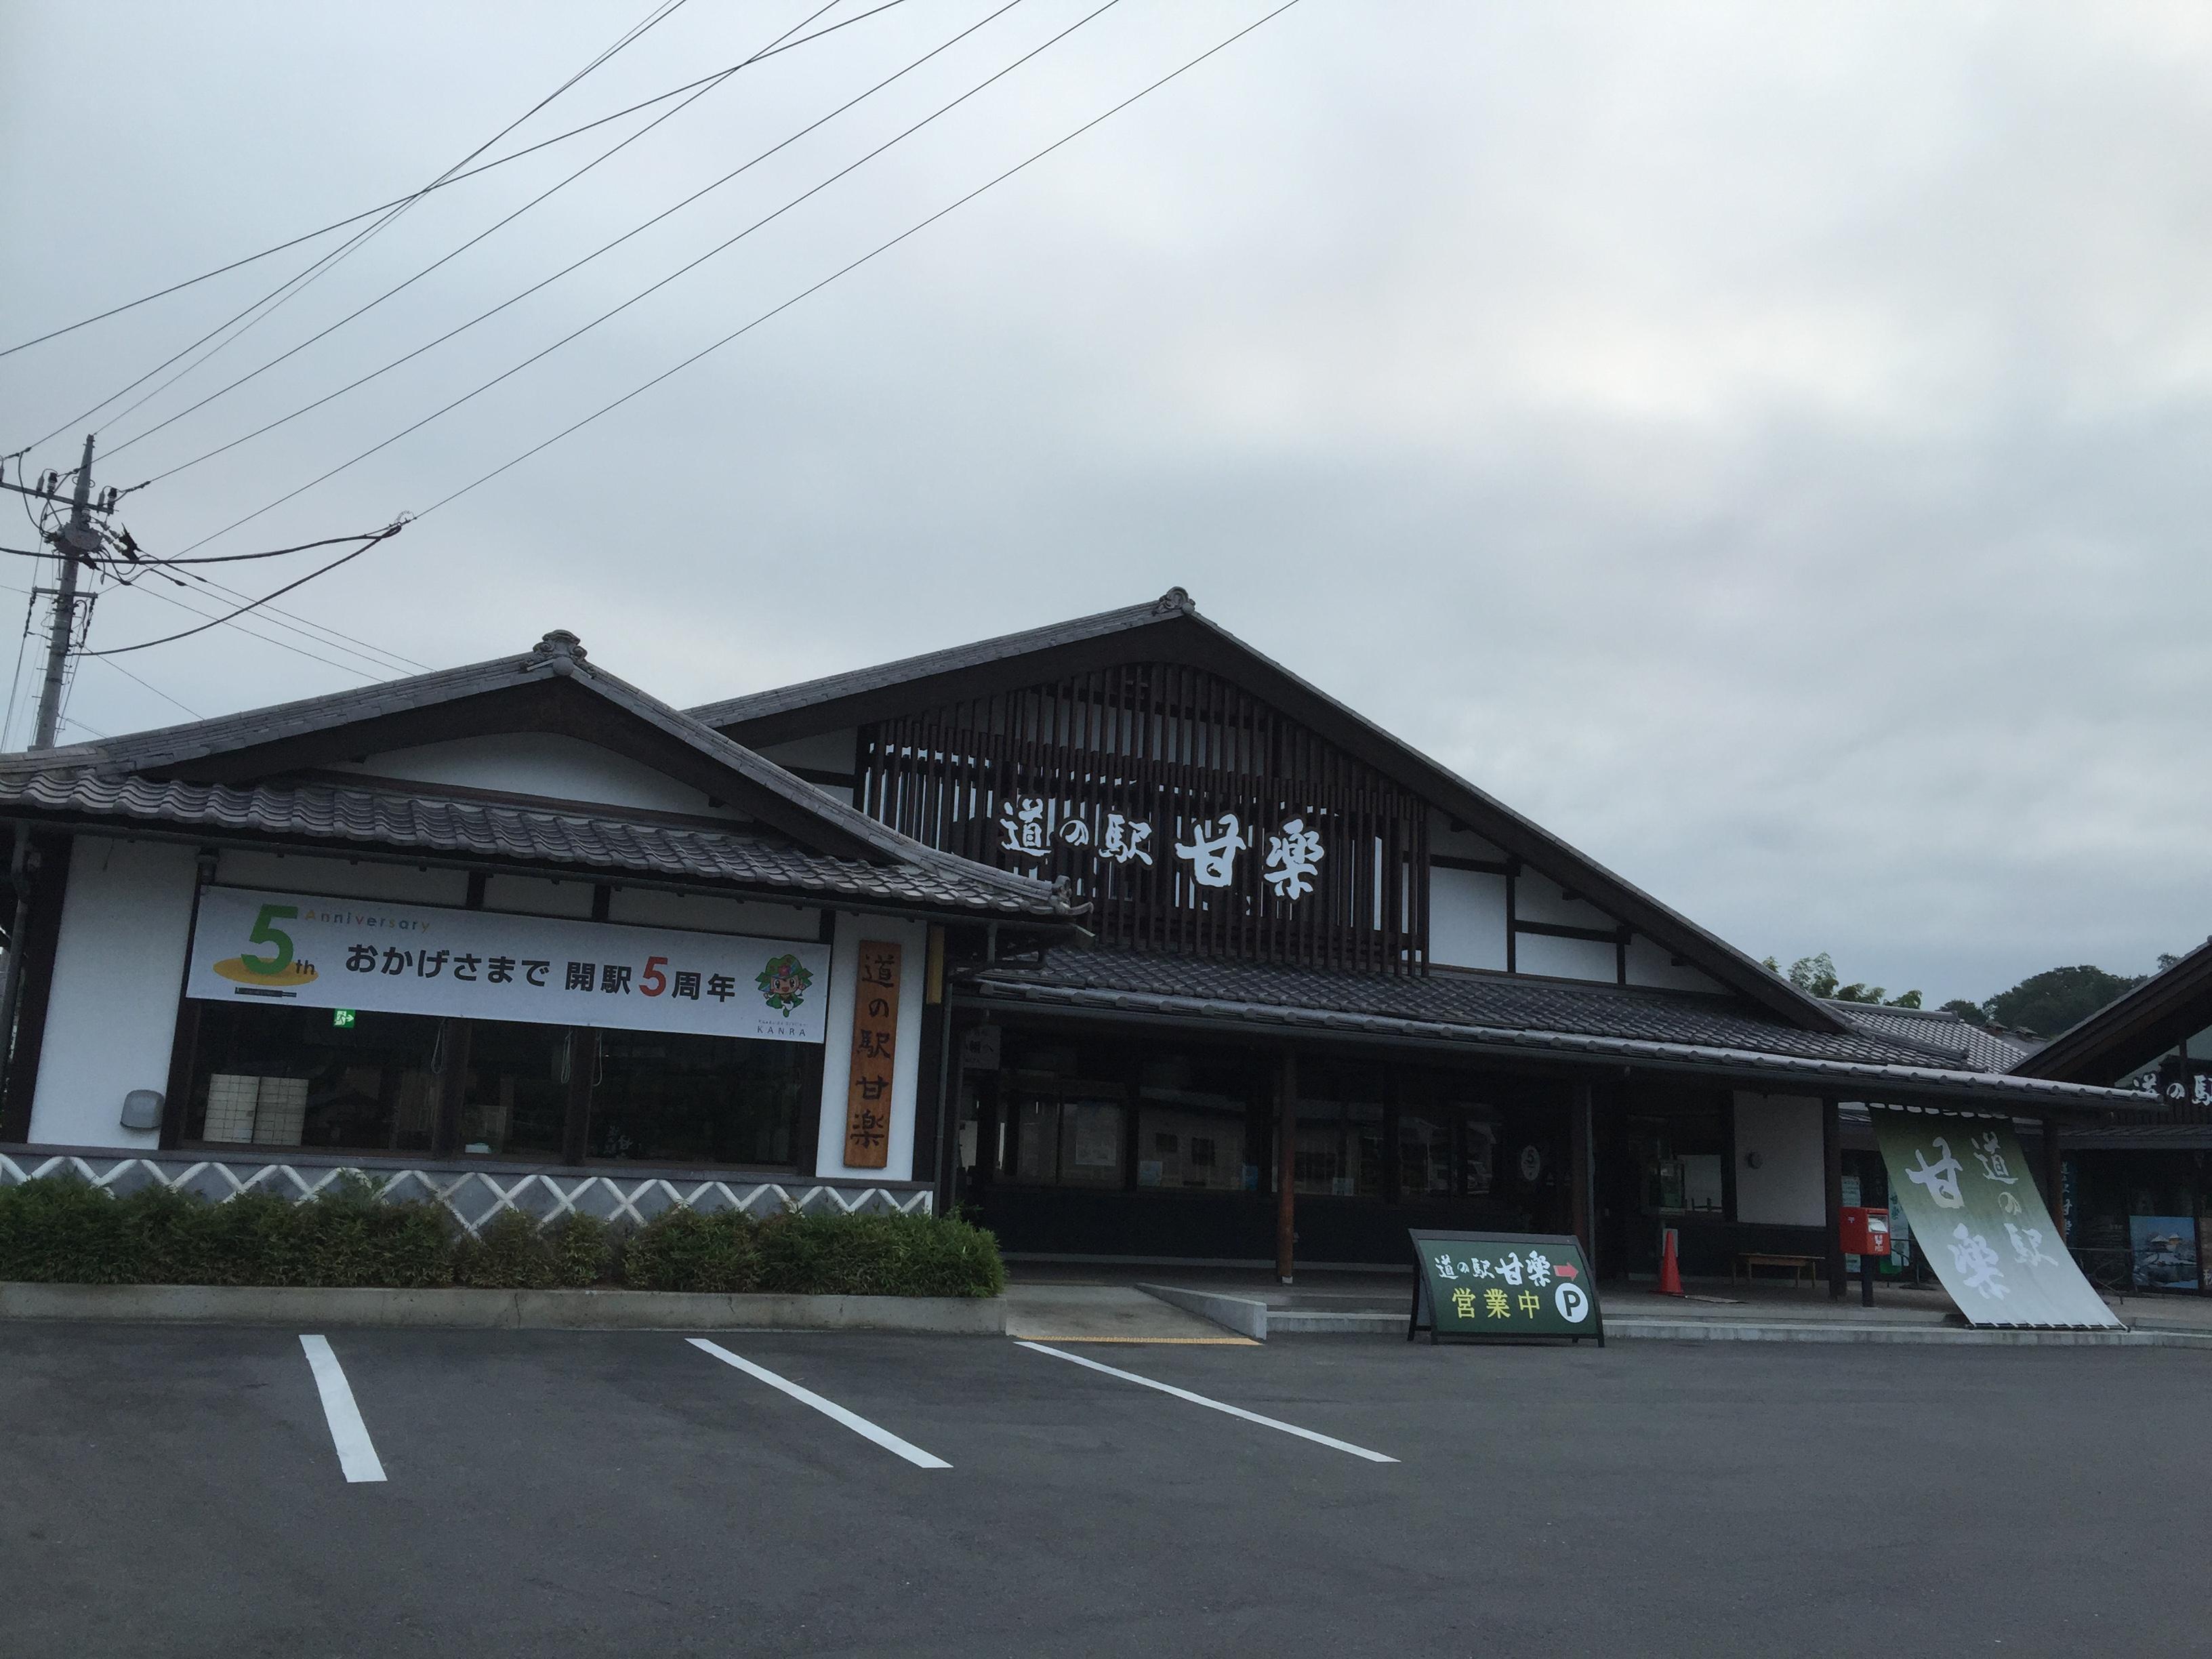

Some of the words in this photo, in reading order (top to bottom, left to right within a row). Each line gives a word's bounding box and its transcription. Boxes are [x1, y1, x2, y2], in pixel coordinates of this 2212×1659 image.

[999, 798, 1153, 865] 道の駅
[1174, 813, 1324, 900] 甘楽
[305, 909, 430, 934] Anniversary
[345, 944, 550, 987] おかげさまで
[565, 956, 736, 1003] 開駅5周年
[757, 1025, 806, 1036] KANRA
[850, 954, 895, 1148] 道の駅甘楽
[1905, 1136, 2011, 1300] 甘楽
[1971, 1131, 2059, 1267] 道の駅
[1452, 1288, 1540, 1319] 営業中
[1563, 1290, 1581, 1317] P
